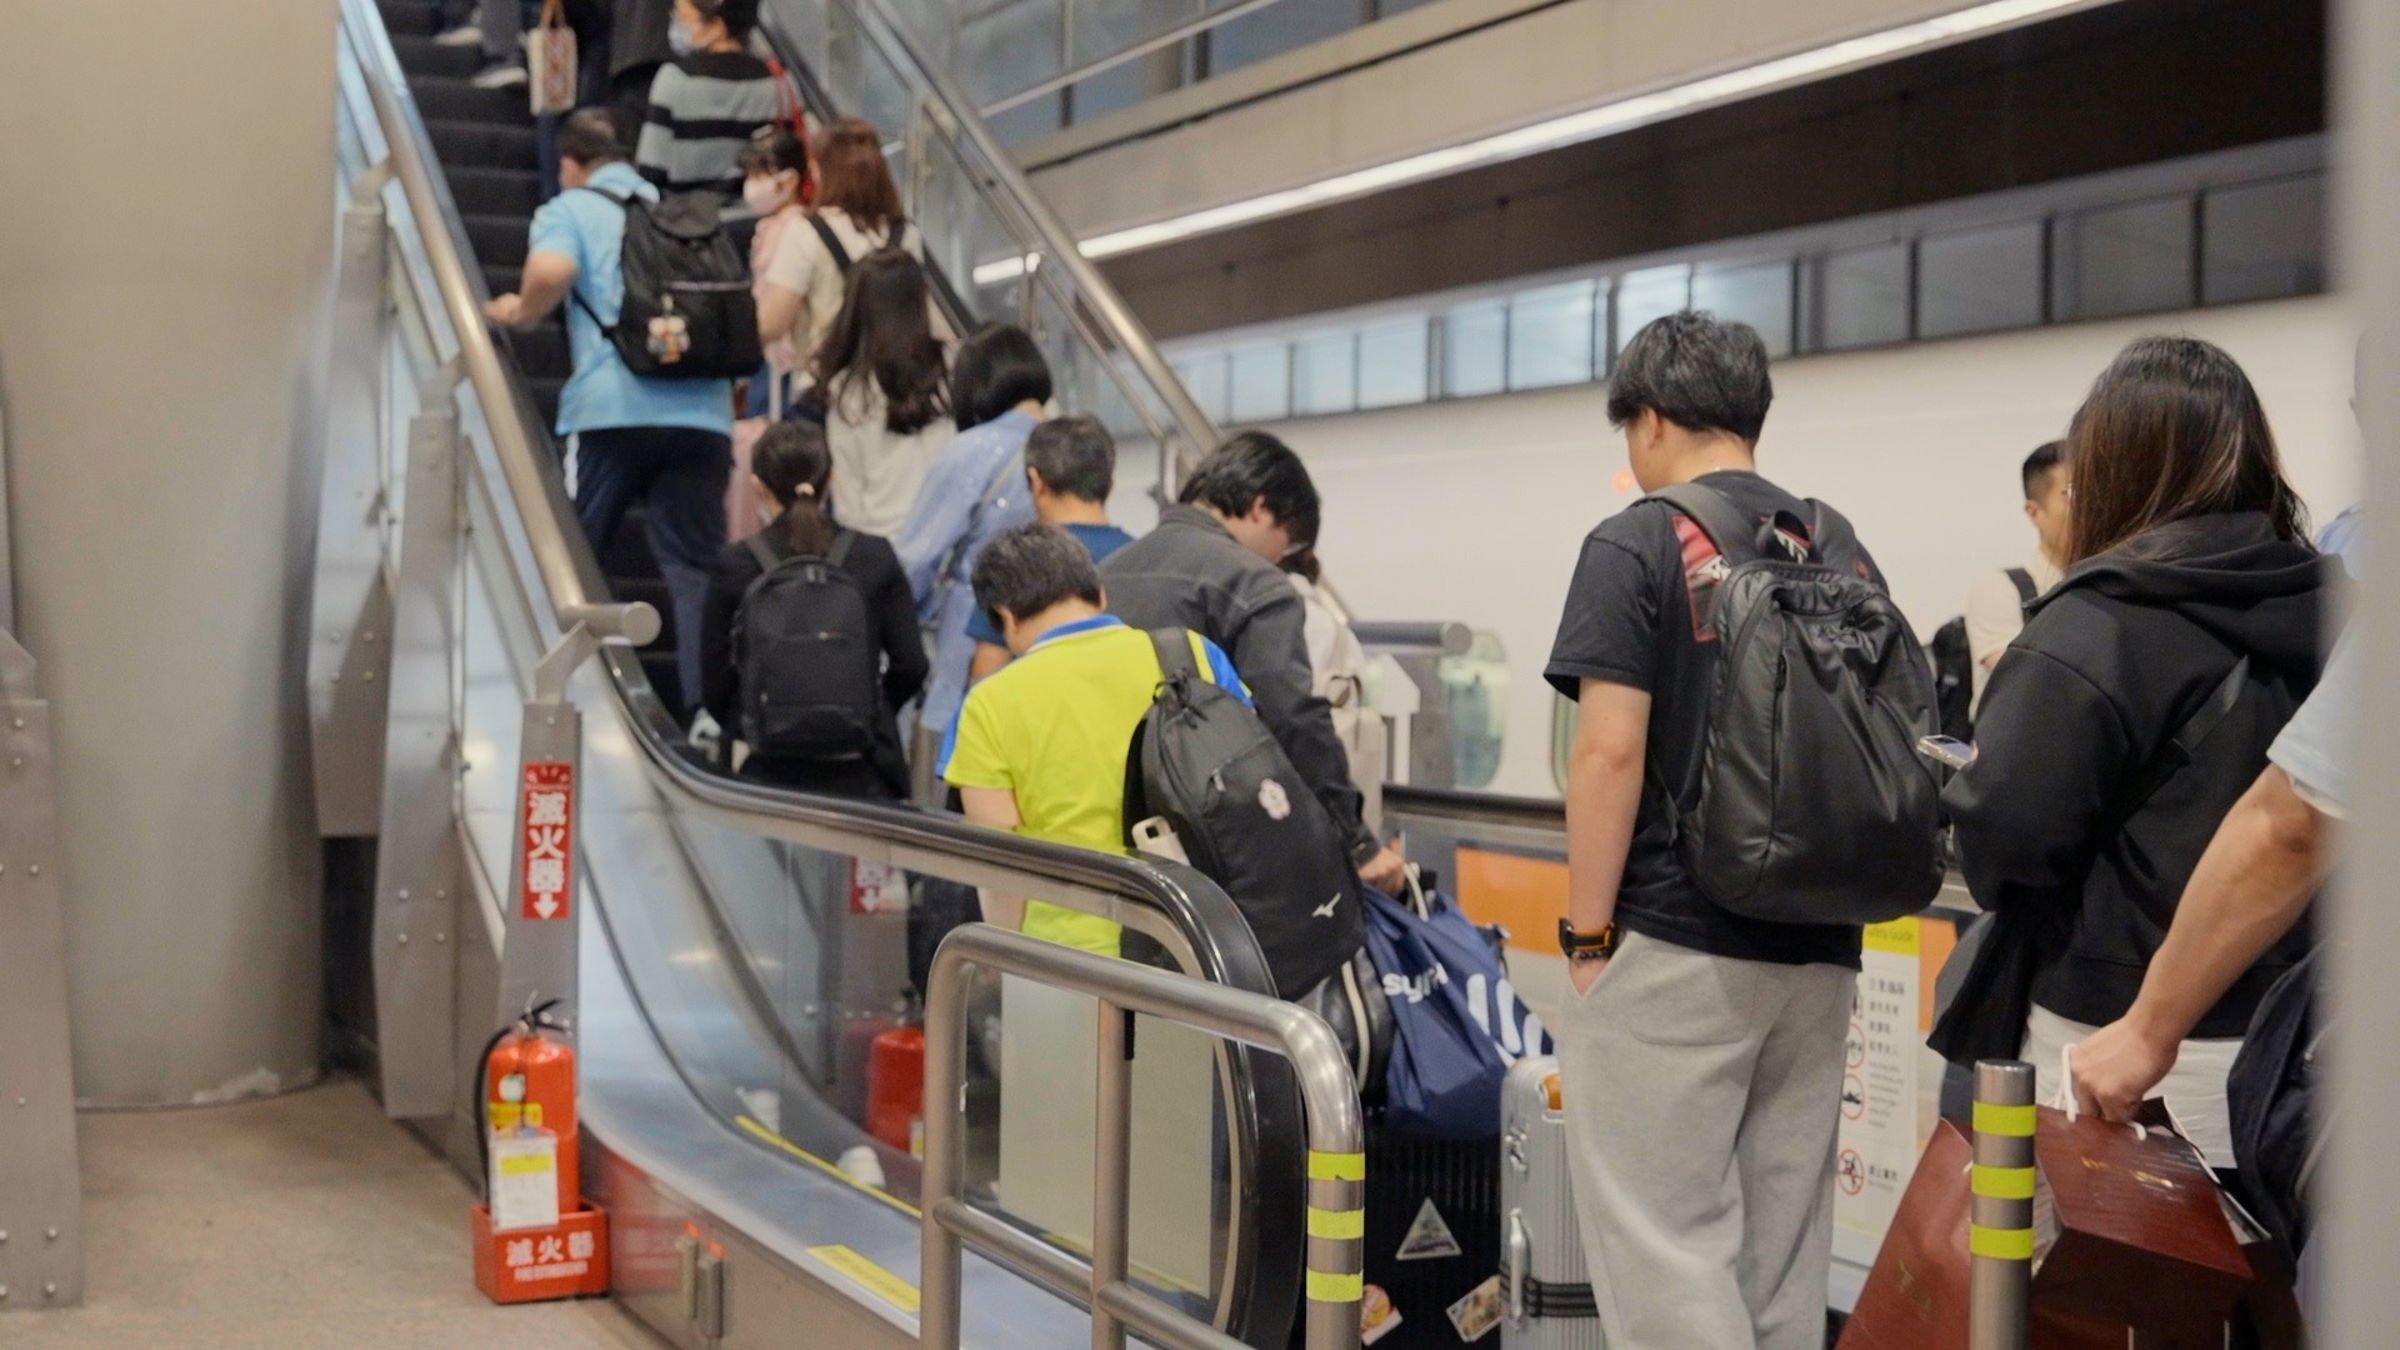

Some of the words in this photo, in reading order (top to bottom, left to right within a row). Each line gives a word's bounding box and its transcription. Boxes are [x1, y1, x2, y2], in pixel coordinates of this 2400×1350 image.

[528, 790, 567, 893] 滅火器
[506, 1230, 595, 1267] 滅火器
